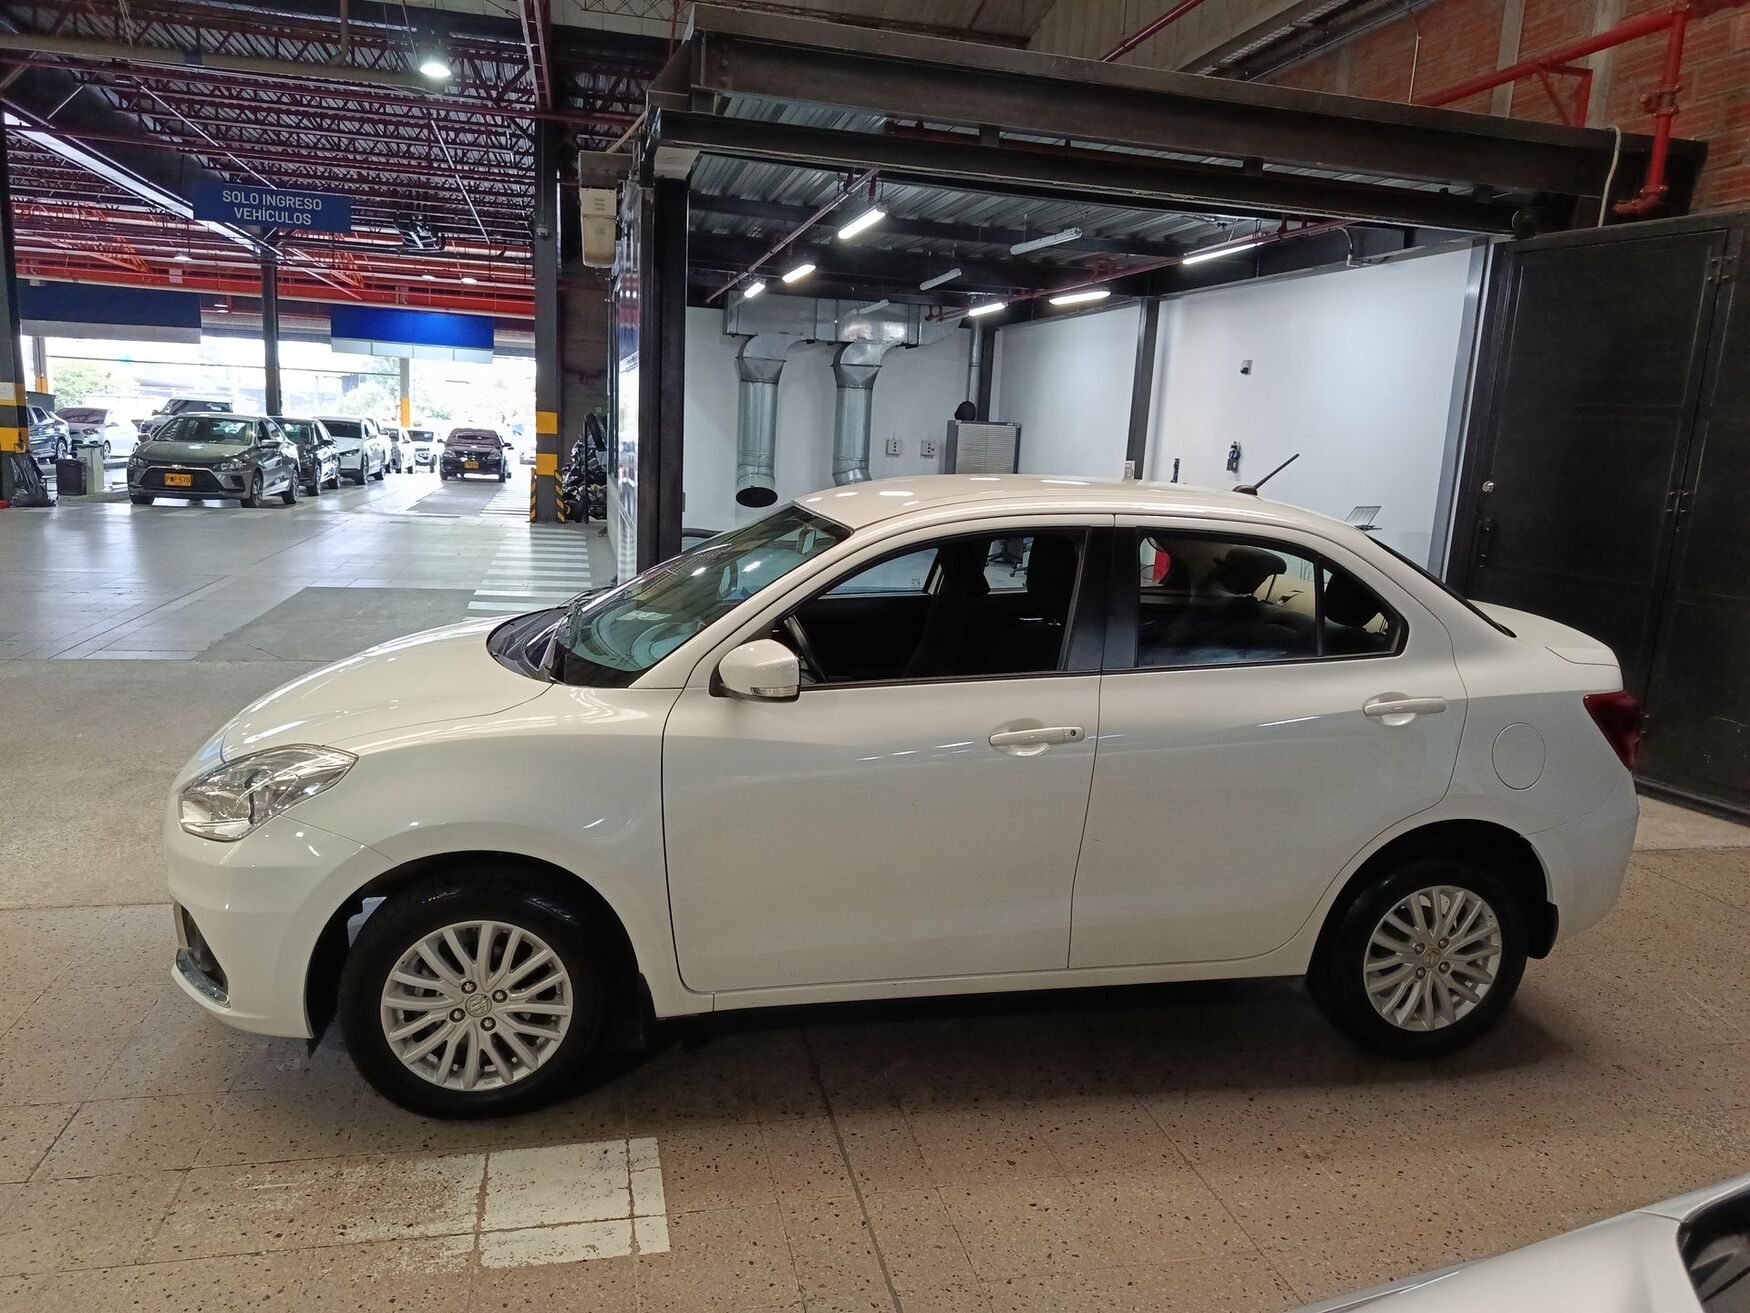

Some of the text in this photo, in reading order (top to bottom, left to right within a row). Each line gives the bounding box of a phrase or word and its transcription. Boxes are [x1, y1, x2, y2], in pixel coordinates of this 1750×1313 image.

[222, 190, 322, 211] SOLO INGRESO
[234, 207, 312, 225] VEHÍCULOS
